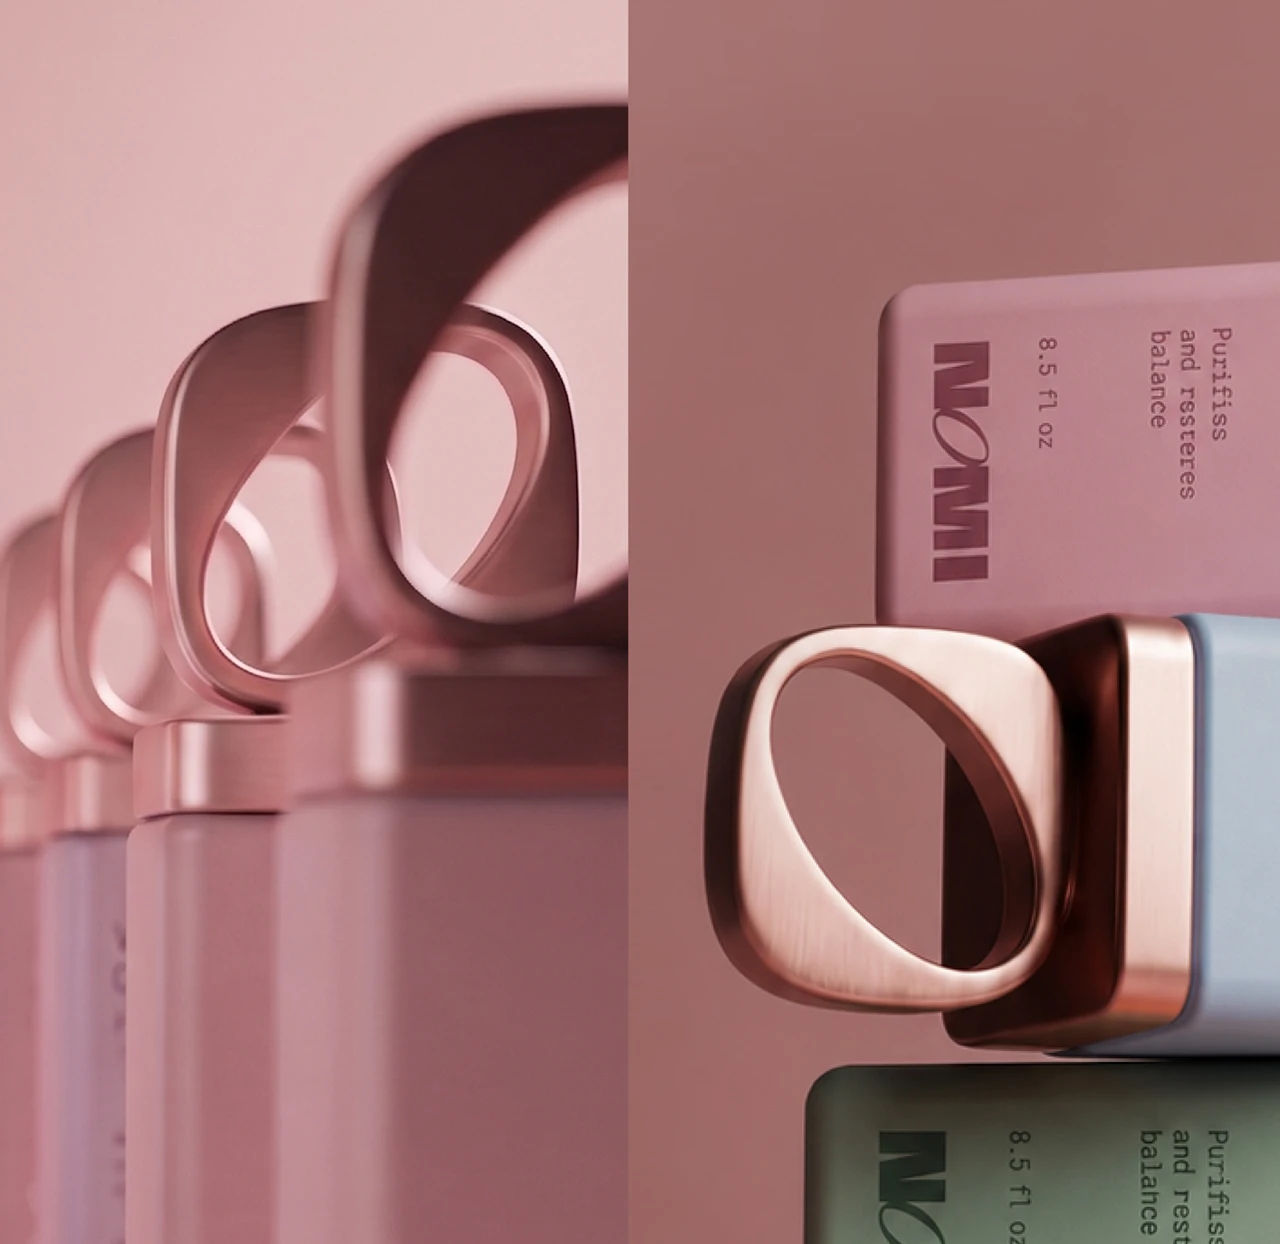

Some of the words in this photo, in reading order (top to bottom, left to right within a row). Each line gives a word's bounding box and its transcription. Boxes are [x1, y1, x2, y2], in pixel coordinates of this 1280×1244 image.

[1038, 337, 1058, 377] 8.5
[1179, 329, 1201, 372] and
[1038, 388, 1058, 413] fl
[1150, 330, 1172, 429] balance
[1038, 422, 1054, 449] oz
[932, 340, 991, 583] NOMI
[1008, 1130, 1032, 1172] 8.5
[1172, 1129, 1197, 1175] and
[1009, 1184, 1033, 1208] fl
